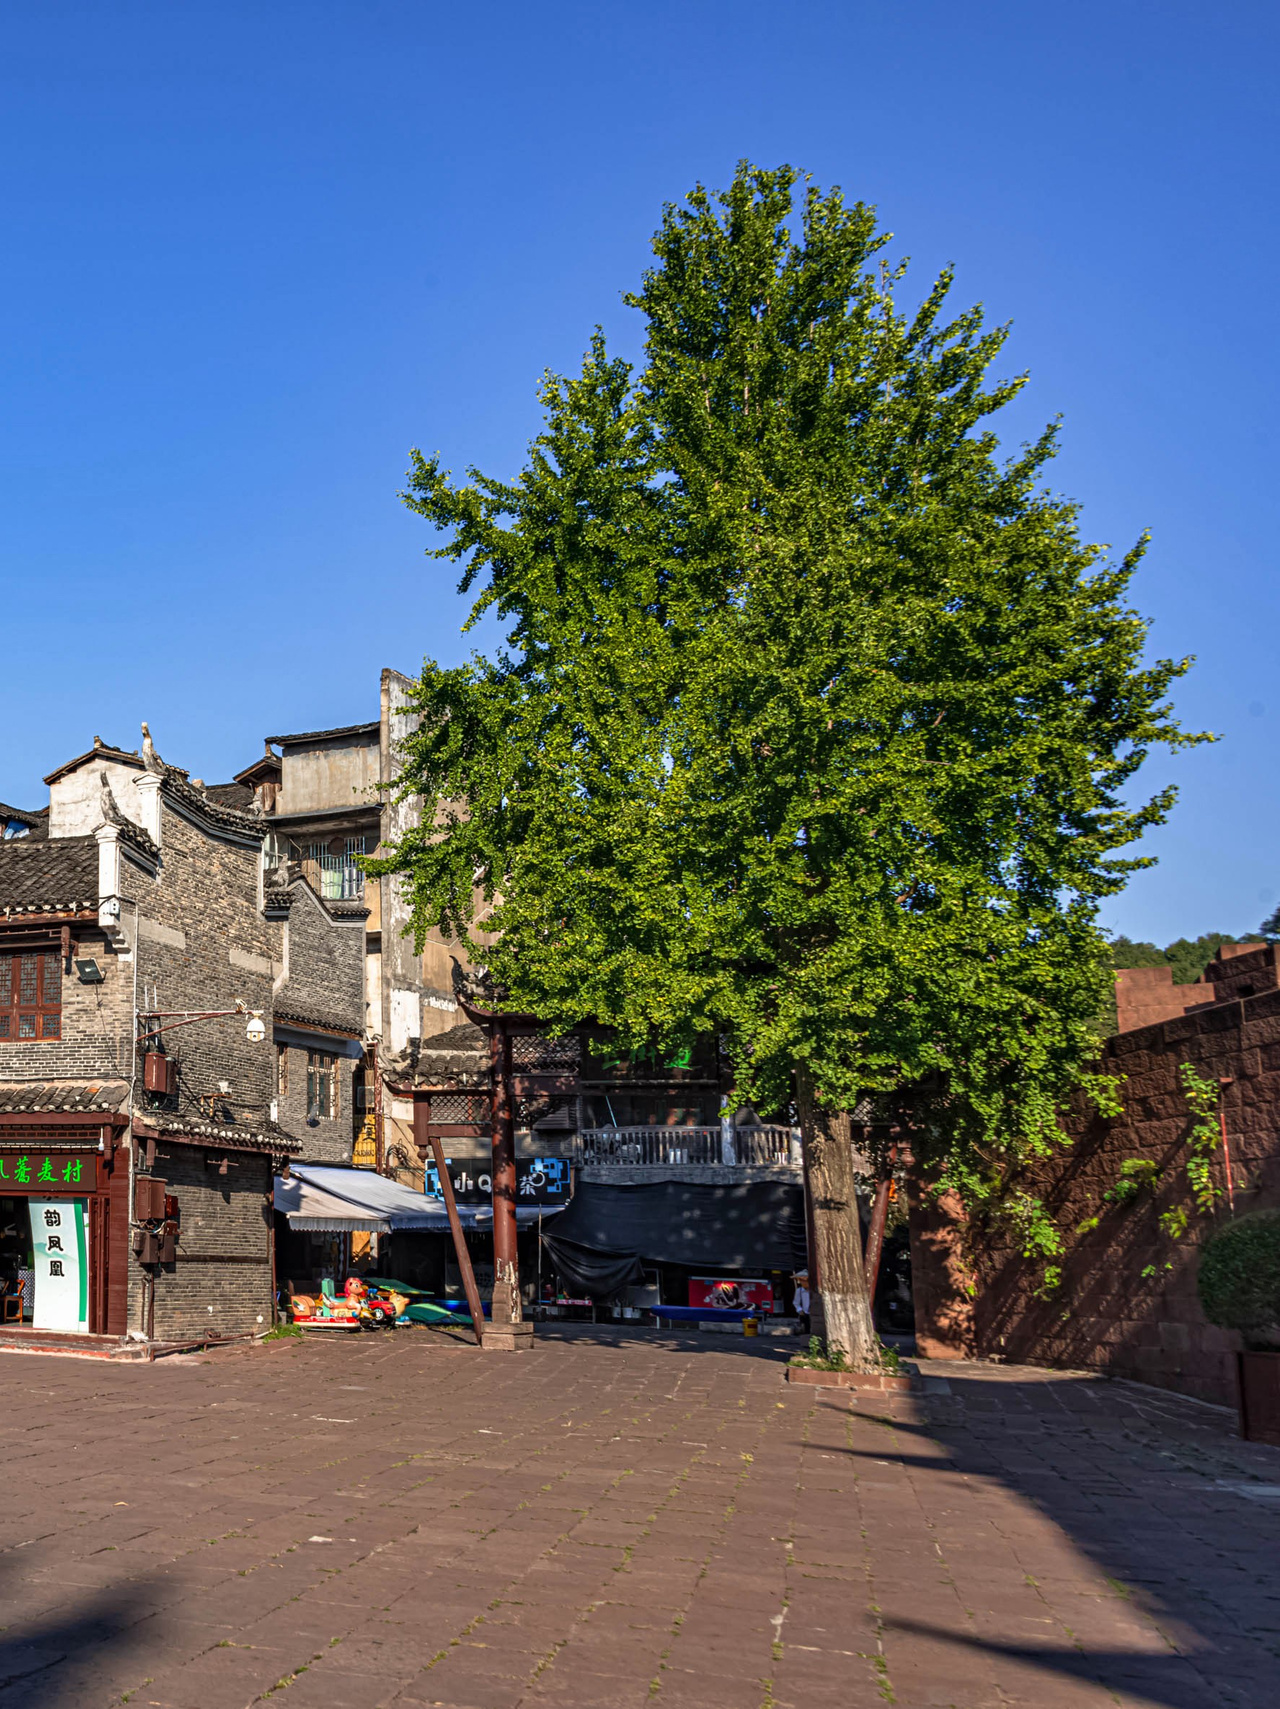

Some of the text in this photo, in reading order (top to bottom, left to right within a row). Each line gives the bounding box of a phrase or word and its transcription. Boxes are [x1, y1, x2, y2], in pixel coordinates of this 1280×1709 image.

[454, 1171, 545, 1196] 小Q茶
[43, 1196, 65, 1277] 韵凤凰
